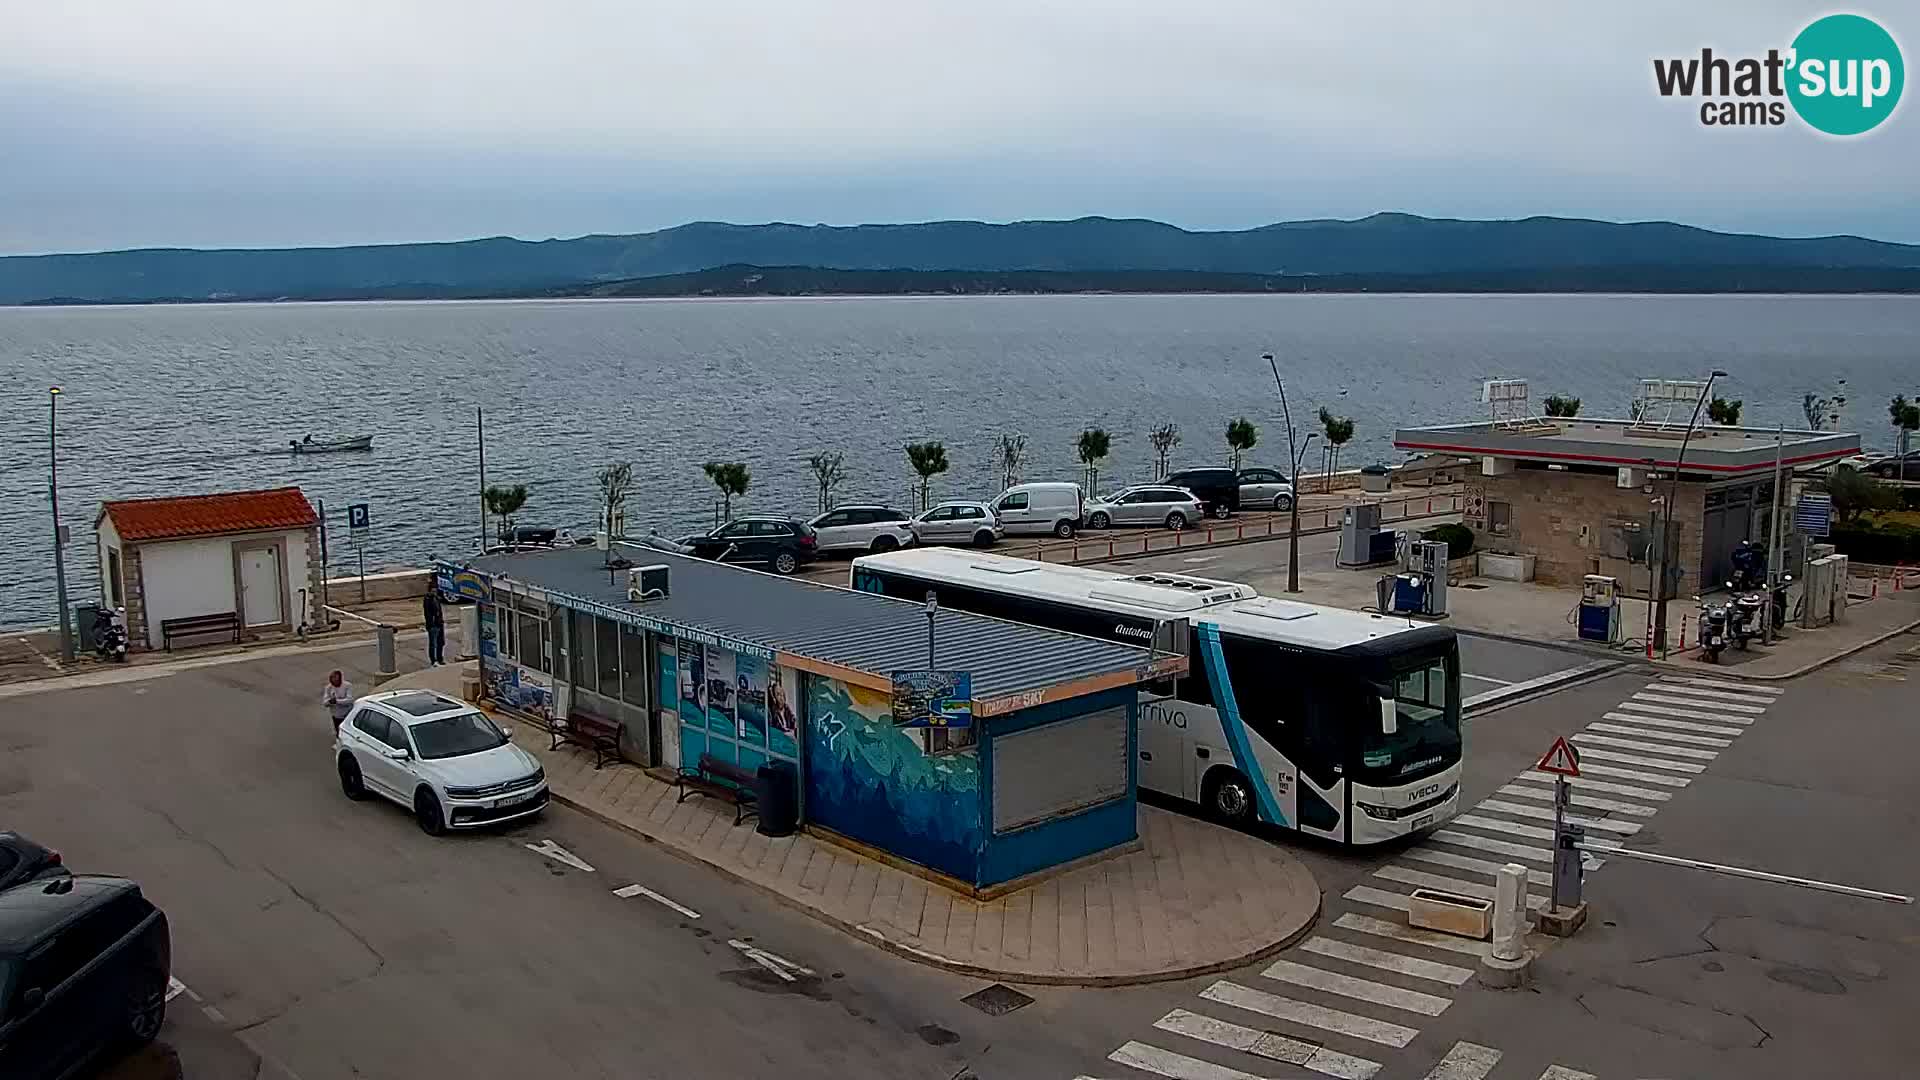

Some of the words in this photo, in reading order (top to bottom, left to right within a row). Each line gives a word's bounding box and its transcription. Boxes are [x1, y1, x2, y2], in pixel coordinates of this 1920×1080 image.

[633, 615, 662, 632] POSTAJA
[672, 626, 687, 638] BUS
[687, 630, 718, 646] STATION
[720, 638, 744, 653] TICKET
[745, 645, 772, 660] OFFICE
[1408, 783, 1439, 802] IVECO
